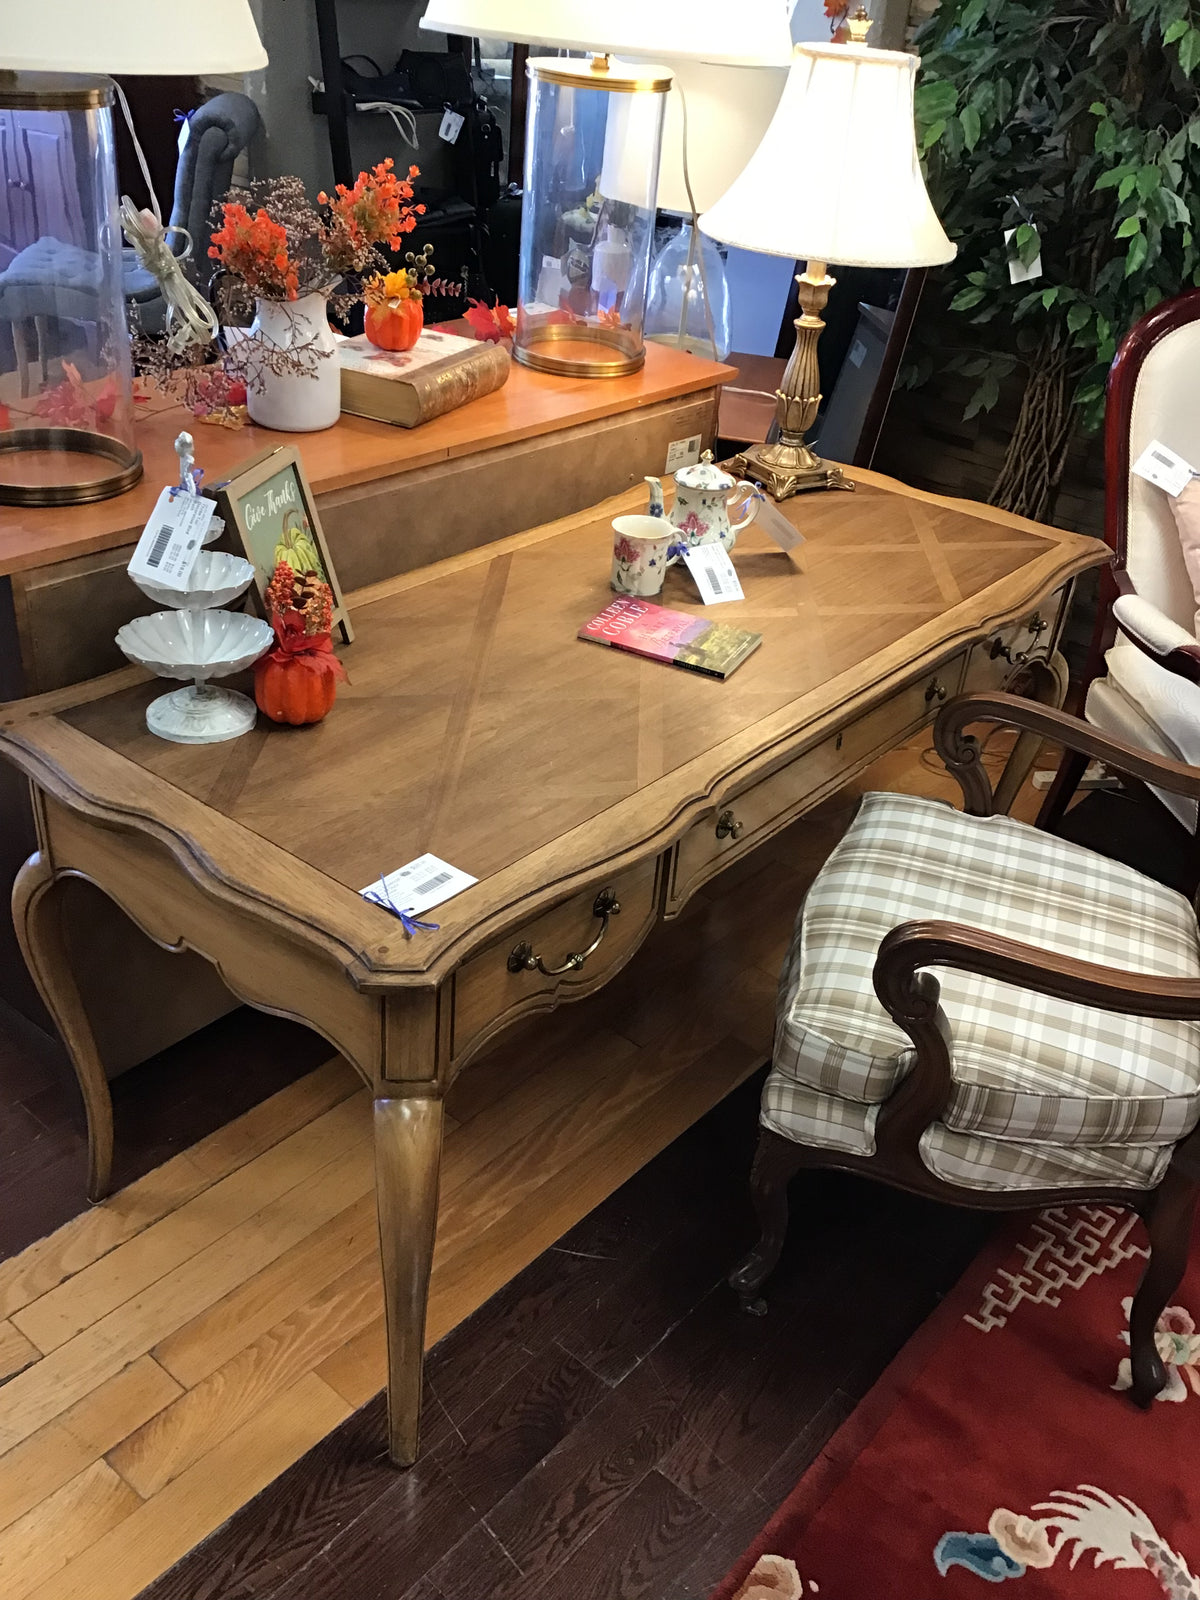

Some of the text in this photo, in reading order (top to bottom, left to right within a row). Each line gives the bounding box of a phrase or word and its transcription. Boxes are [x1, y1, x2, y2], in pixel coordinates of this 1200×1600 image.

[245, 503, 266, 531] Give
[263, 480, 296, 517] Thanks
[586, 597, 631, 631] COLLEEN
[602, 603, 649, 636] COBLE
